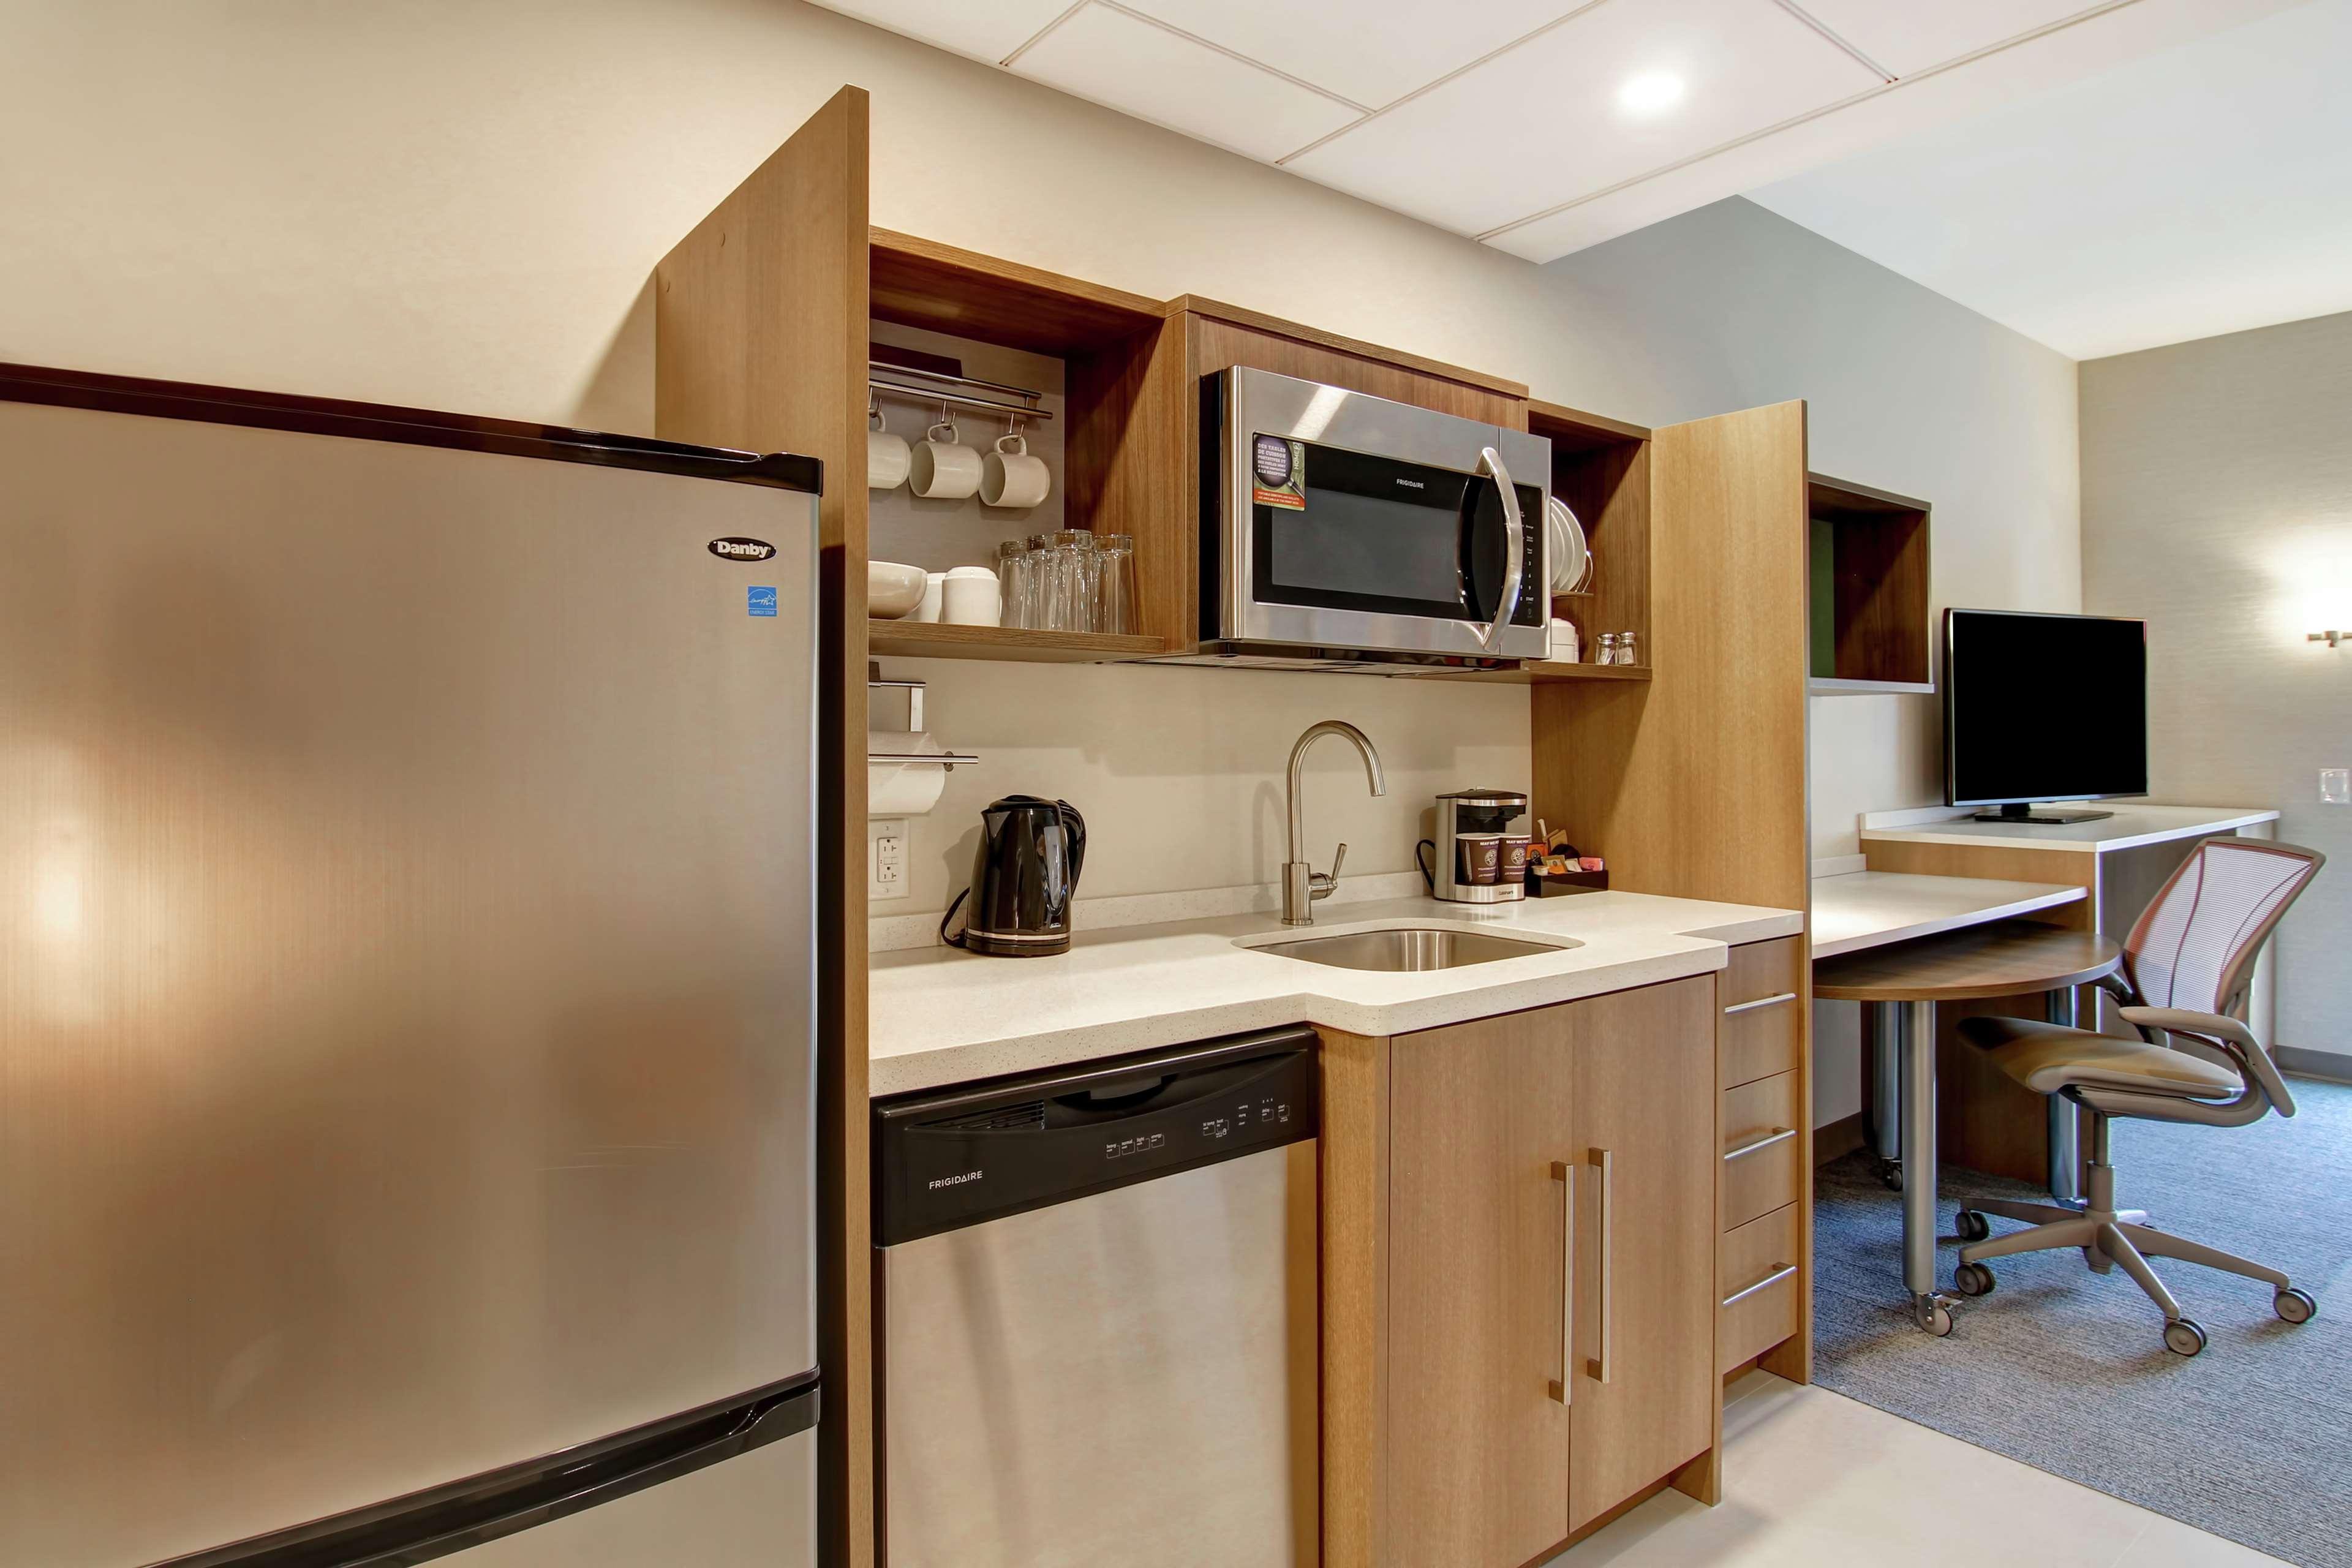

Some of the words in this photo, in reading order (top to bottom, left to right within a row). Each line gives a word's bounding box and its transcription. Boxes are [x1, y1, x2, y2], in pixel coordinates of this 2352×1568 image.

[1396, 478, 1424, 489] FRIGIDAIRE
[717, 541, 768, 558] Danby
[929, 1170, 982, 1189] FRIGIDAIRE
